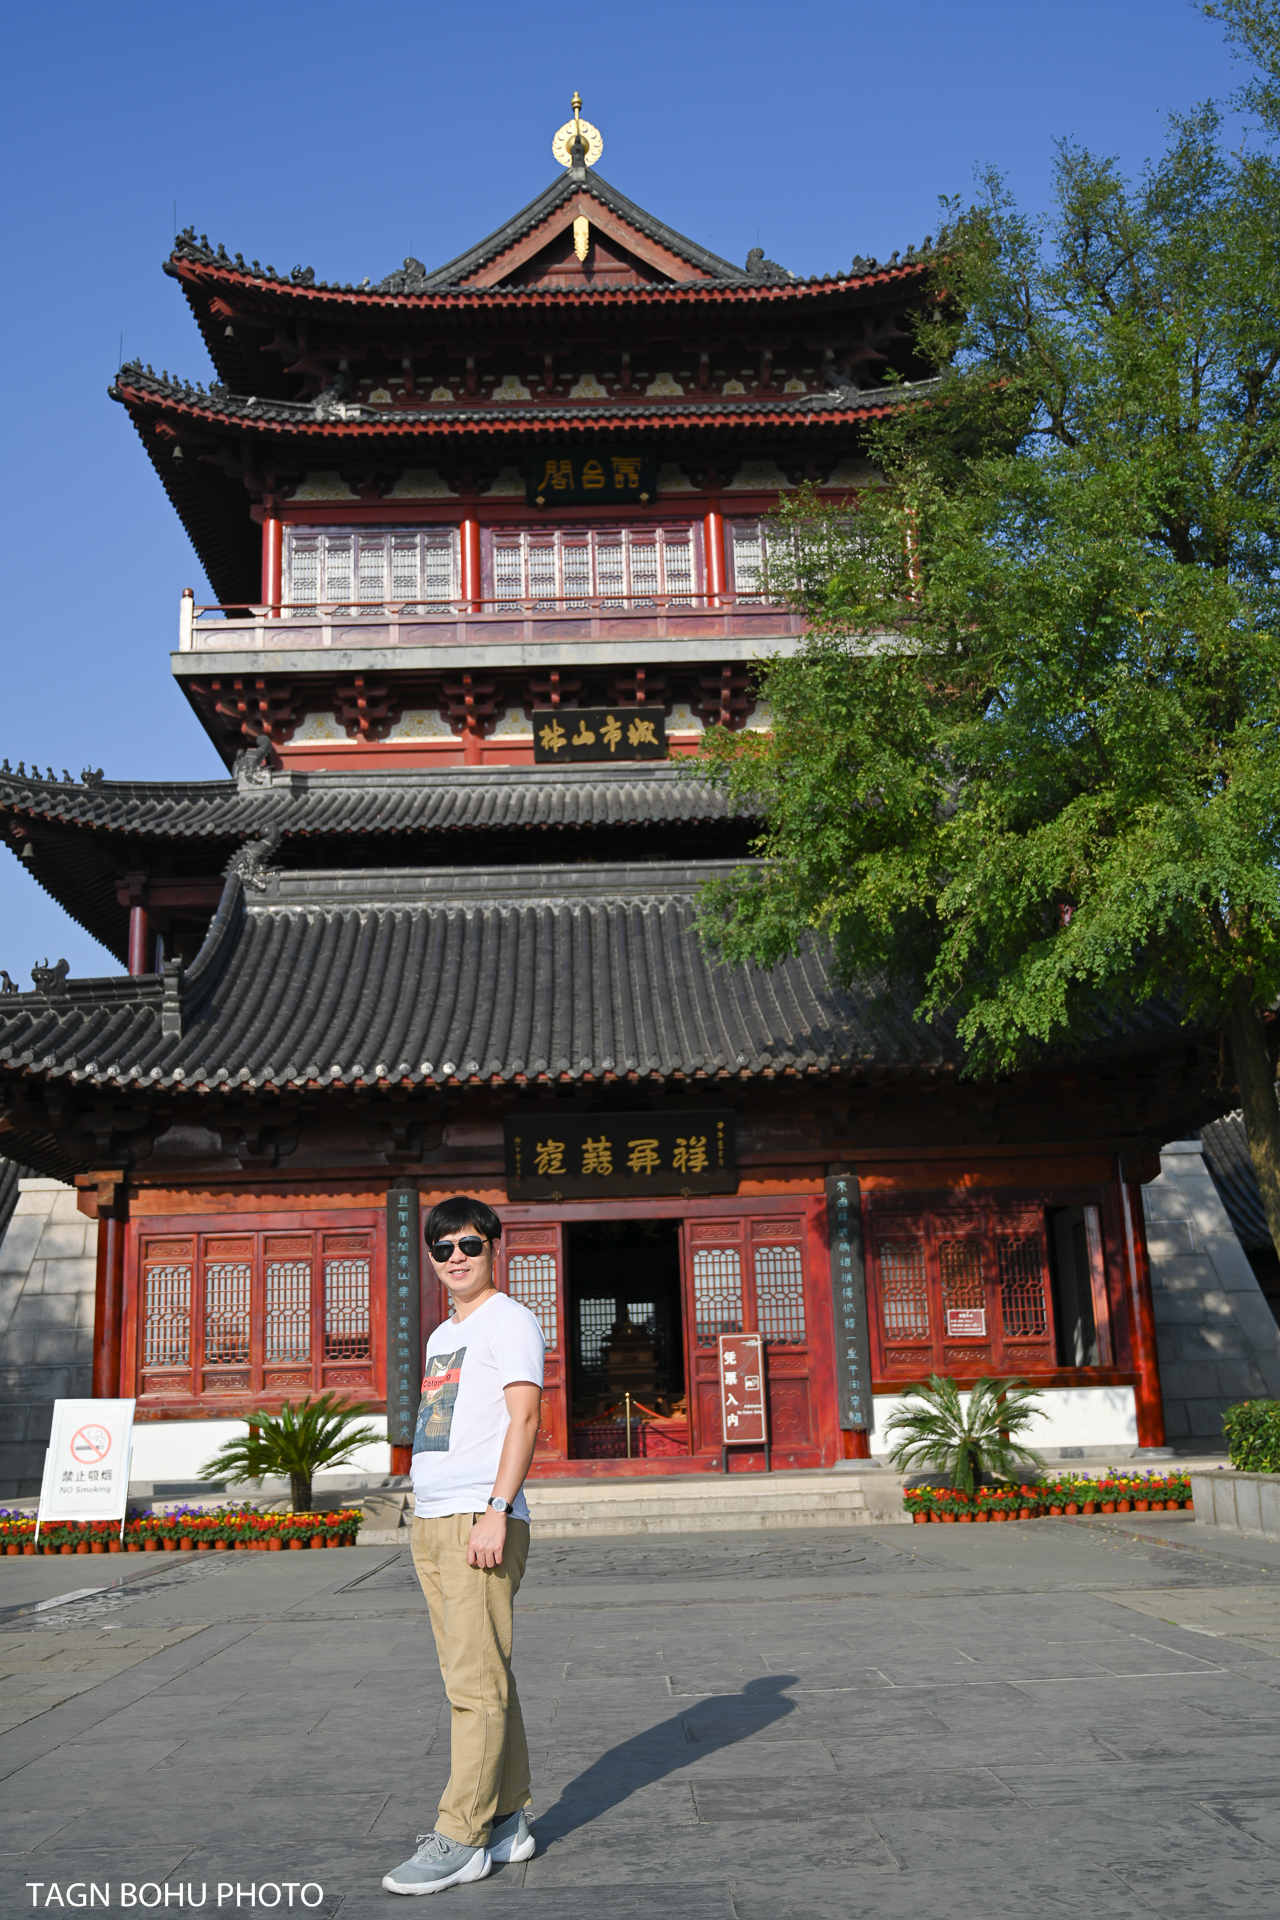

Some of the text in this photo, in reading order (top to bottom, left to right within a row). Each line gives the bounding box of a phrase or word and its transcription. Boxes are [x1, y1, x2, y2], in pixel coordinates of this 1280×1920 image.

[723, 1351, 739, 1427] 凭票入内
[61, 1469, 113, 1483] 禁止吸烟
[59, 1485, 112, 1494] NO Smoking
